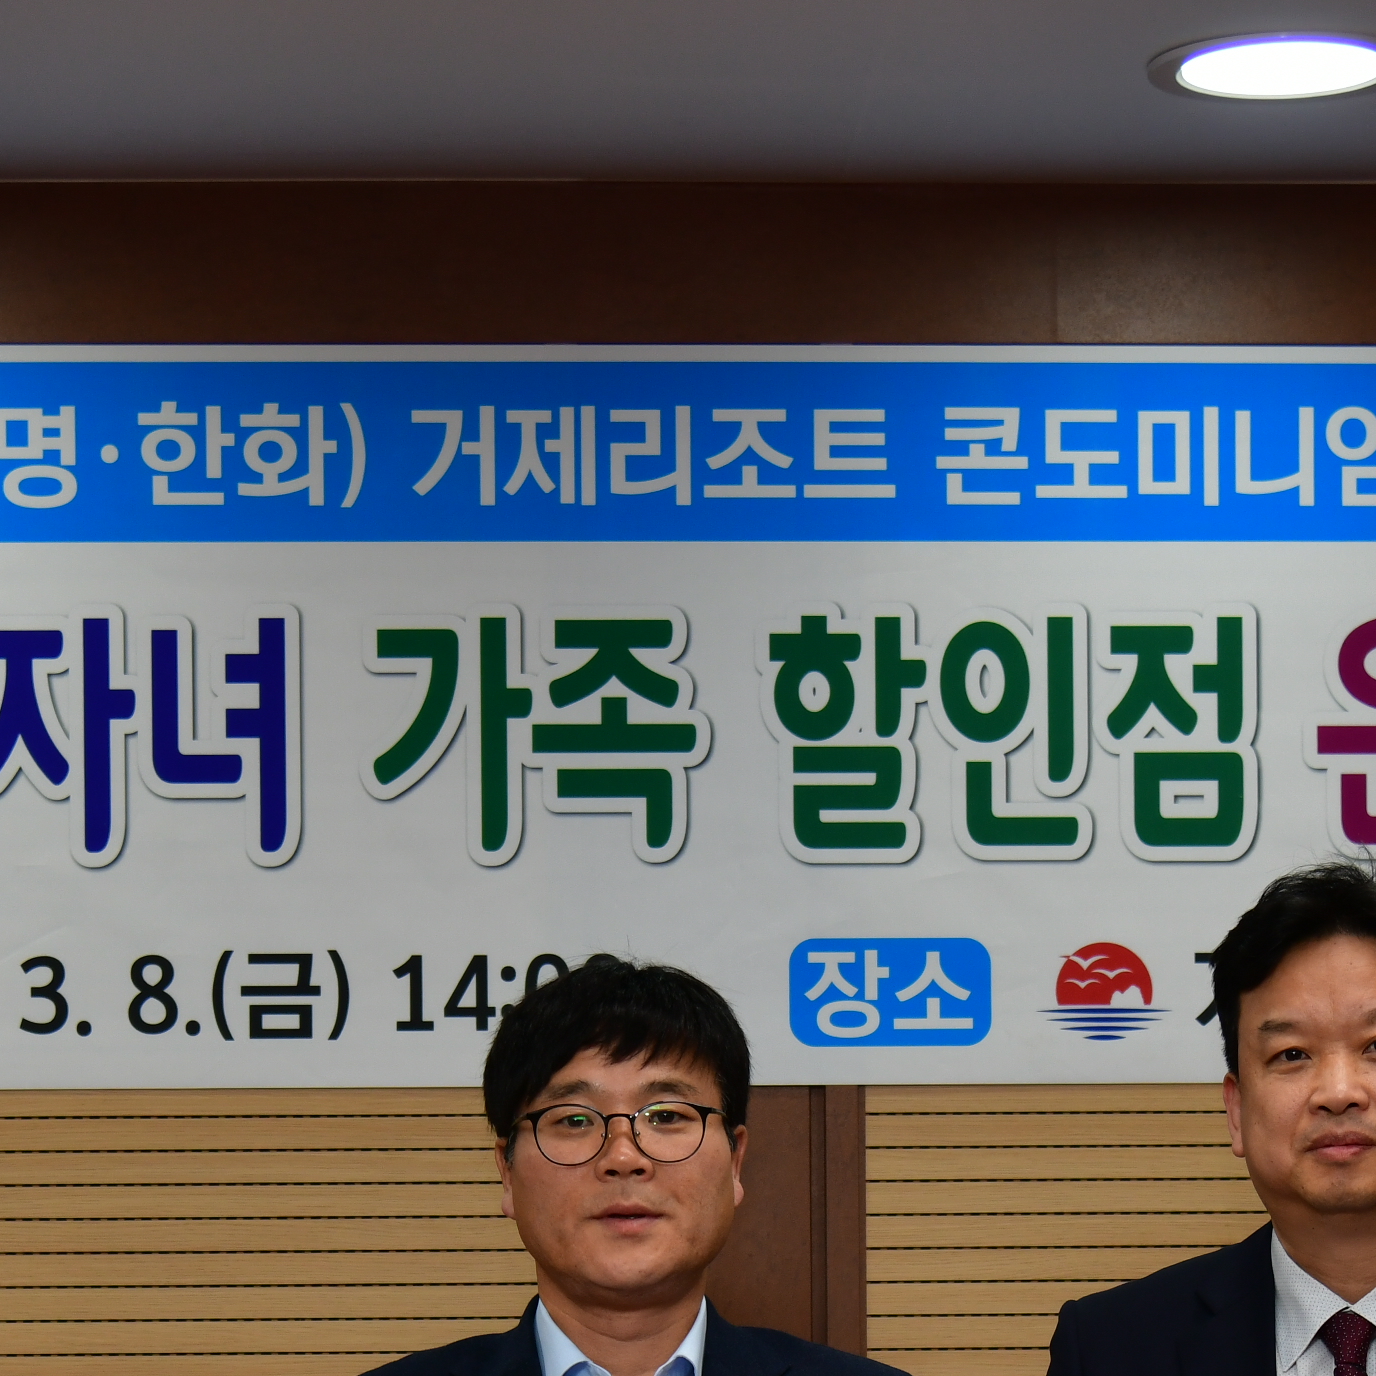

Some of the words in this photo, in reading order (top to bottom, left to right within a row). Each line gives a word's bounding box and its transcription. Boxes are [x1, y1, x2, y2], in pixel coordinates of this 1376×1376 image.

[412, 406, 895, 505] 거제리조트
[374, 618, 696, 851] 가족
[770, 616, 1243, 848] 할인점
[20, 956, 91, 1037] 3.
[805, 949, 974, 1037] 장소
